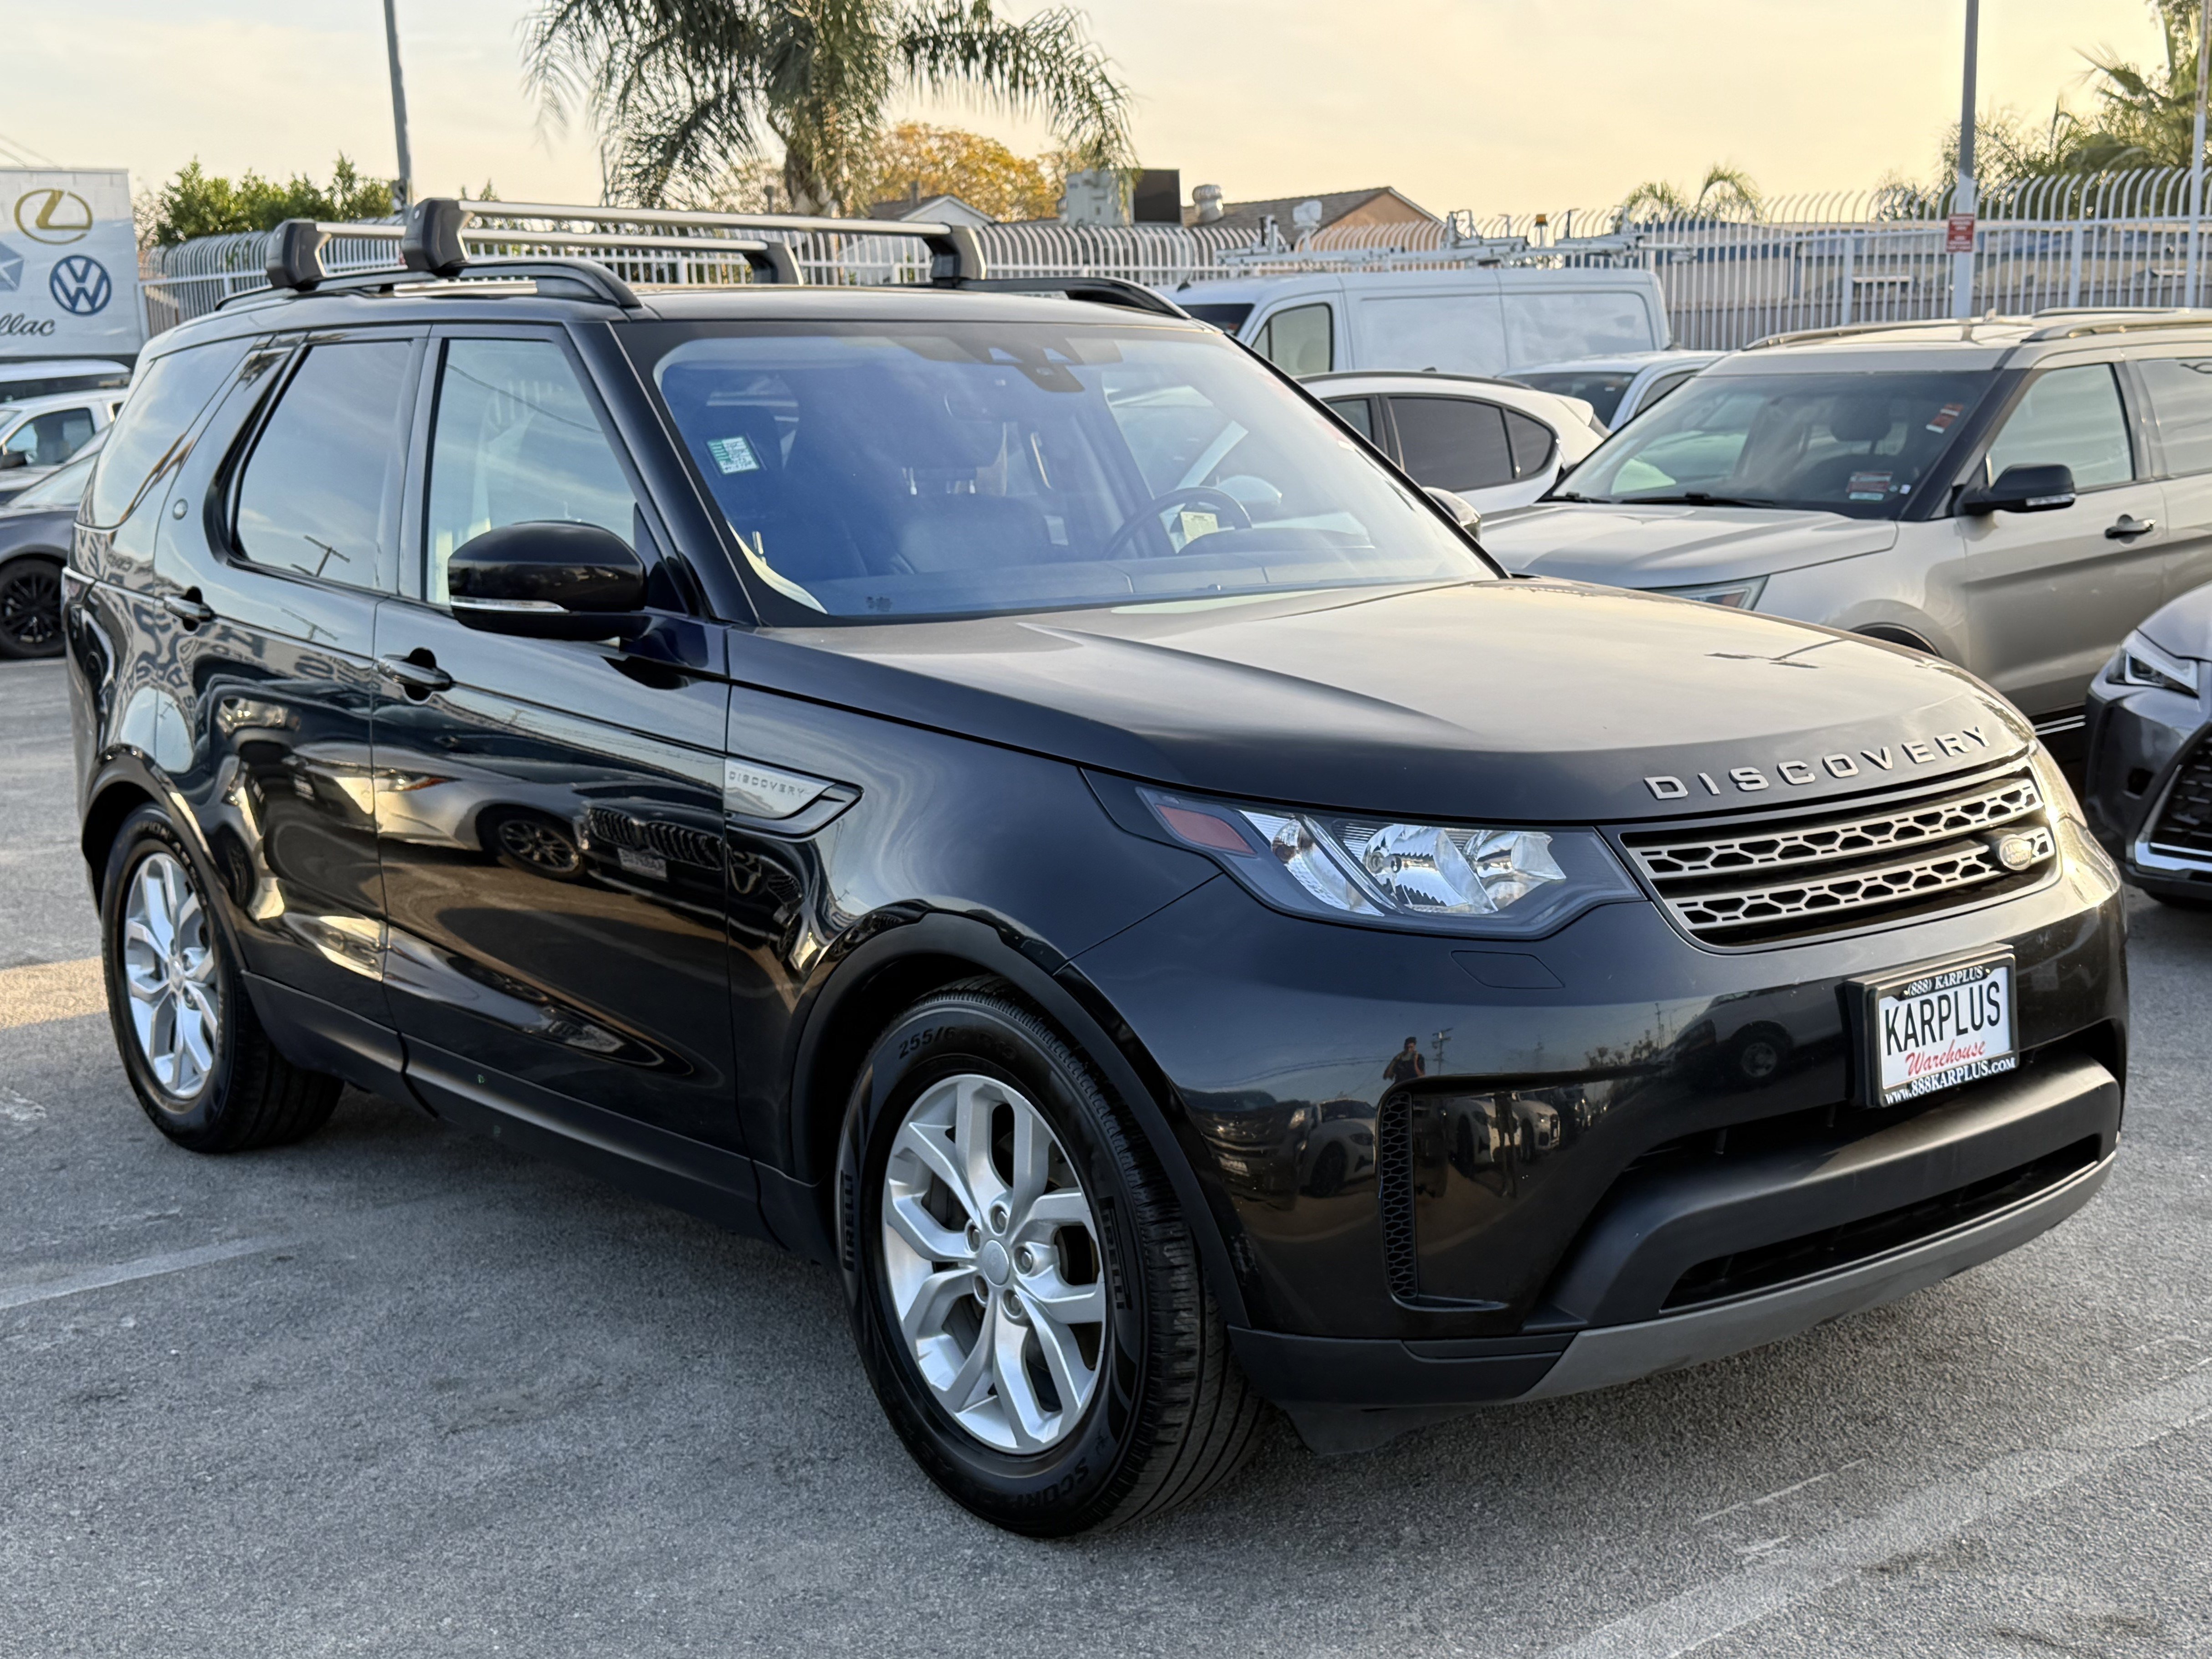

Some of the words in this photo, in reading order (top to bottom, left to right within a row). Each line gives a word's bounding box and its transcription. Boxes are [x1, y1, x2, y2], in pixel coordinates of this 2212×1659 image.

[1643, 725, 1991, 801] DISCOVERY
[729, 770, 806, 798] DISCOVERY
[1908, 978, 1932, 997] (888)
[1935, 965, 1984, 990] KARPLUS
[1885, 981, 2001, 1055] KARPLUS
[1905, 1038, 1986, 1077] Warehouse
